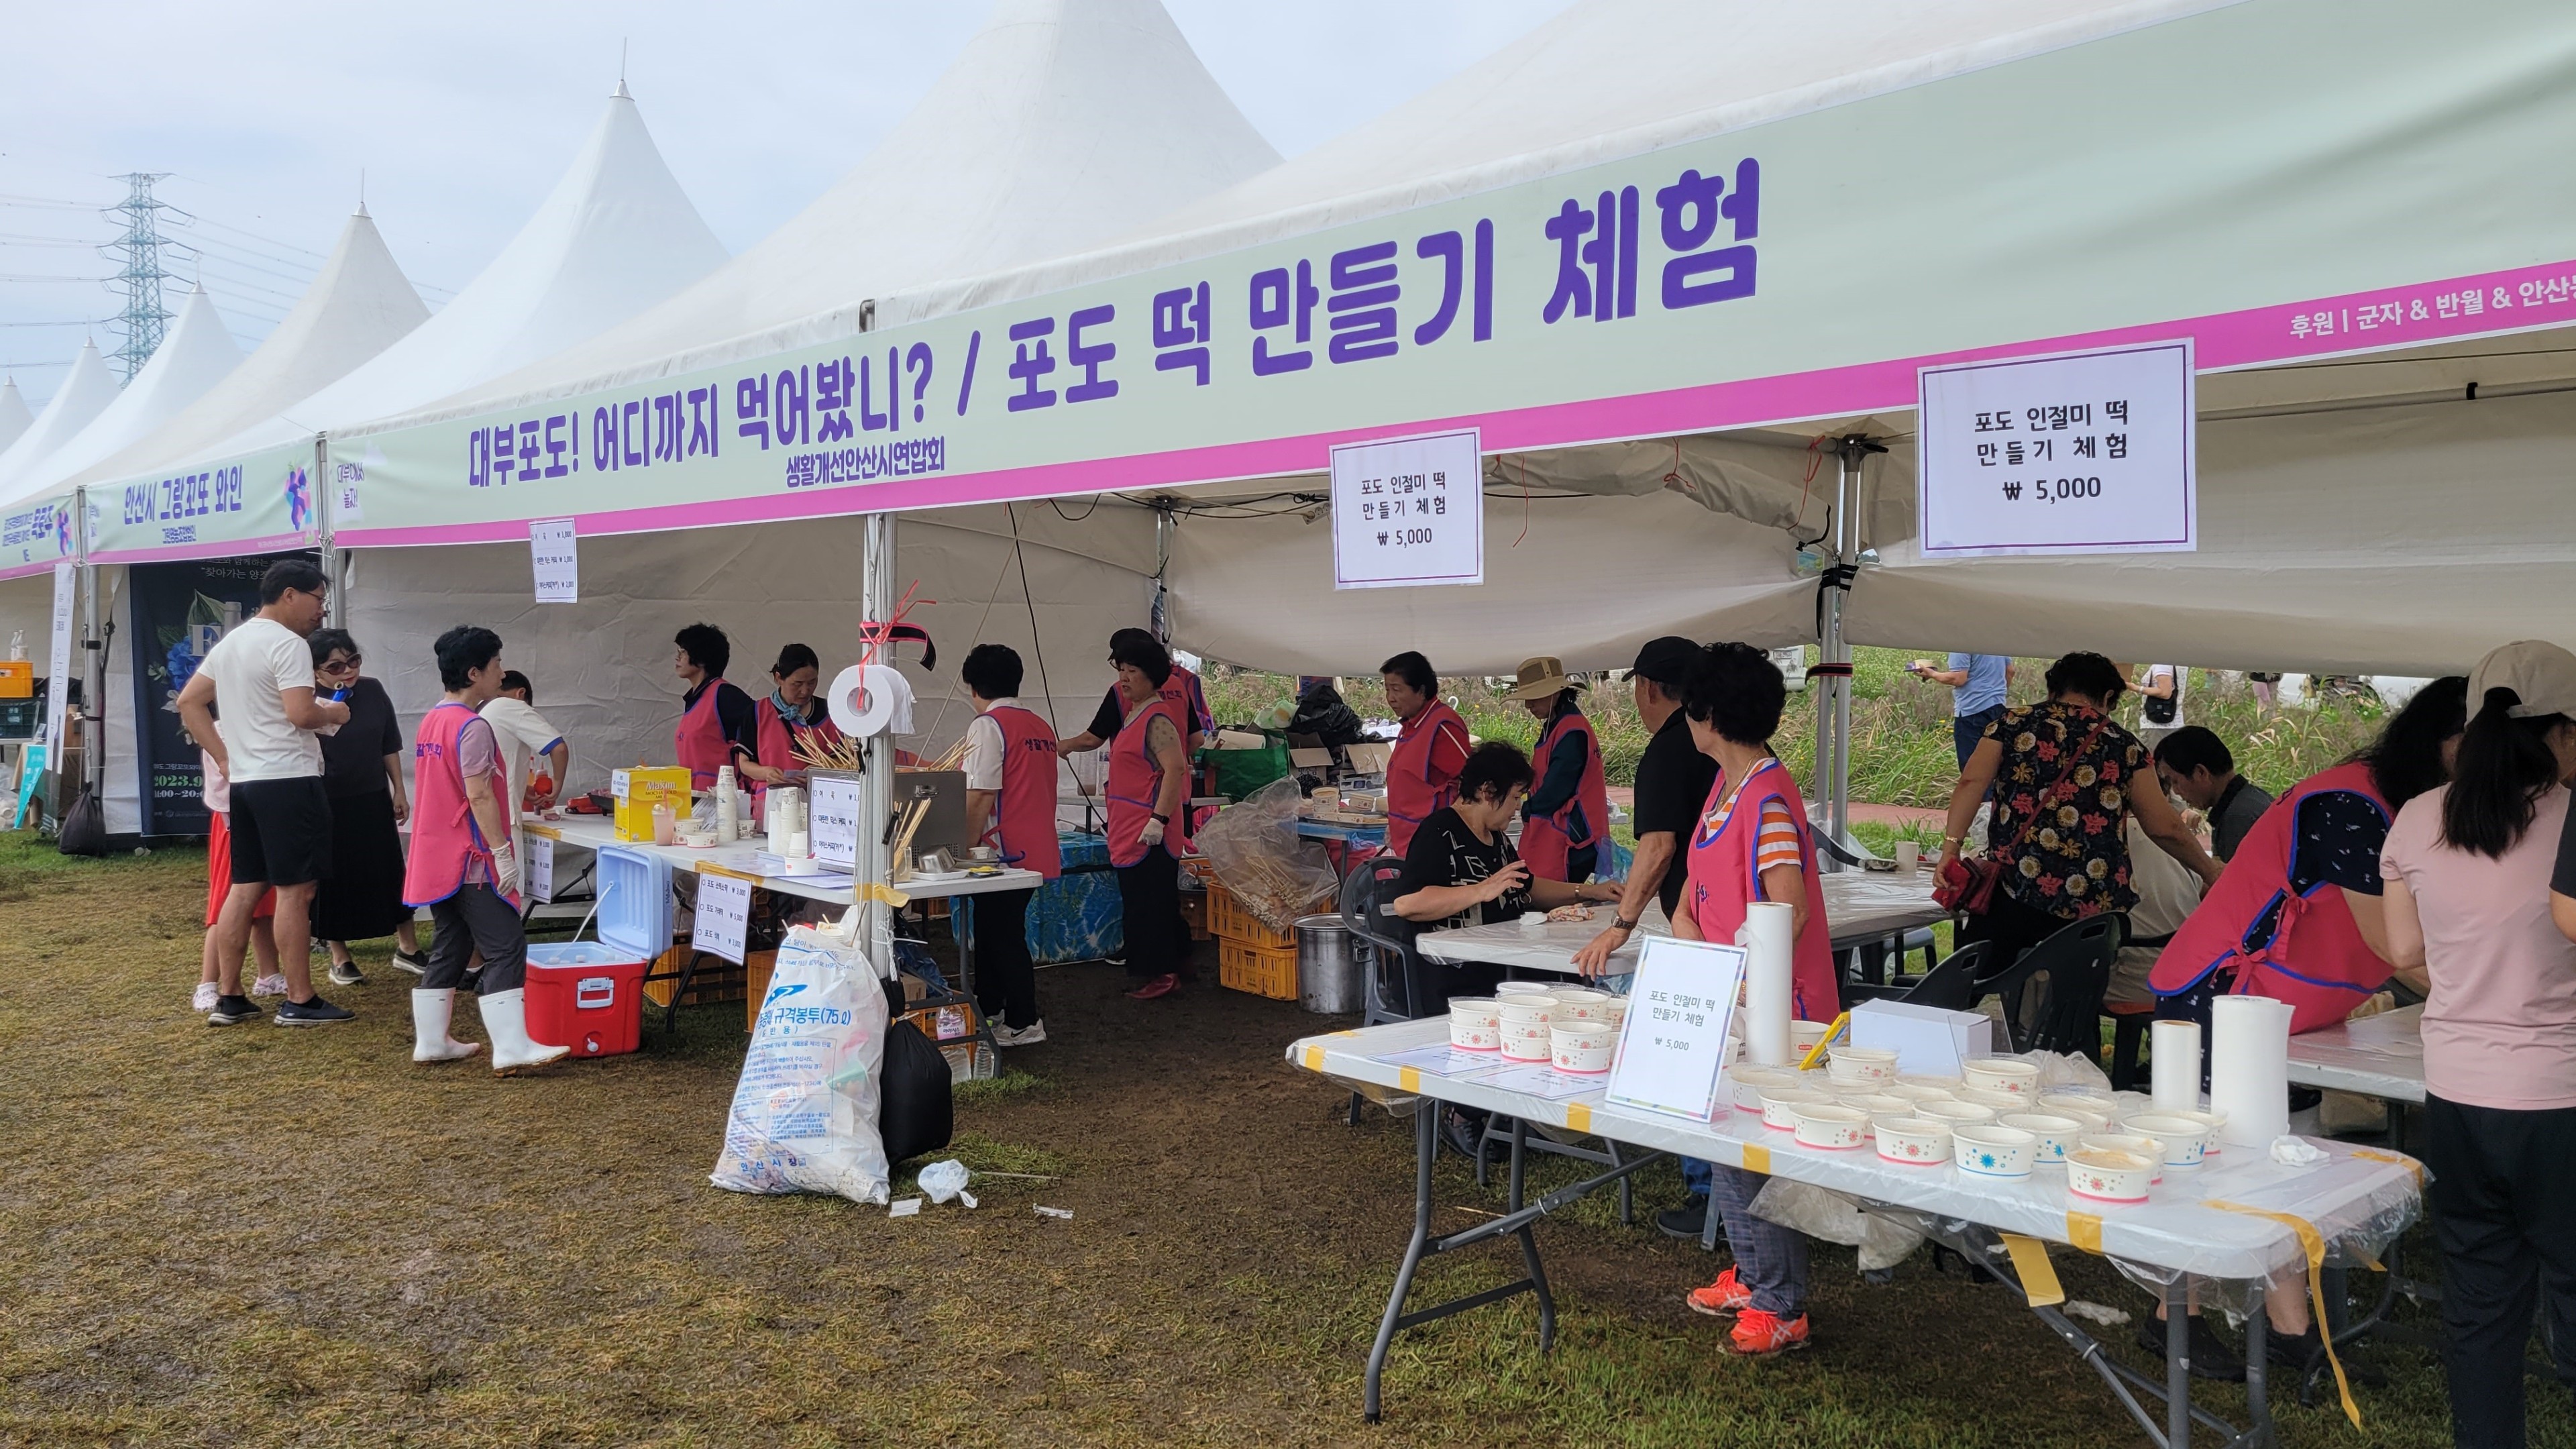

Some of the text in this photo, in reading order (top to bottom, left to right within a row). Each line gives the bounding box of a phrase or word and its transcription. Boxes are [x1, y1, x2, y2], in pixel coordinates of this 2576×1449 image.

[470, 157, 1760, 487] 대부포도! 어디까지 먹어봤니? / 포도 떡 만들기 체험
[2290, 312, 2334, 338] 후원
[2356, 302, 2403, 330] 군자
[2410, 299, 2429, 320] &
[2436, 290, 2483, 319] 반월
[2491, 286, 2512, 309] &
[1974, 400, 2129, 433] 포도 인절미 떡
[786, 435, 945, 488] 생활개선안산시연합회
[1977, 433, 2127, 467] 만들기 체험
[124, 464, 243, 525] 안산시 그랑꼬또 와인
[1361, 472, 1446, 495] 포도 인절미 떡
[2036, 477, 2102, 504] 5,000
[1362, 496, 1446, 521] 만들기 체험
[1396, 528, 1433, 549] 5,000
[647, 782, 677, 790] Maxim
[707, 879, 714, 888] 포도
[736, 888, 746, 896] 3,000
[706, 904, 714, 912] 포도
[734, 914, 743, 922] 5,000
[704, 929, 713, 937] 포도
[1649, 990, 1715, 1012] 포도 인절미 떡
[1652, 1008, 1705, 1027] 만들기 체험
[1666, 1039, 1690, 1051] 5,000
